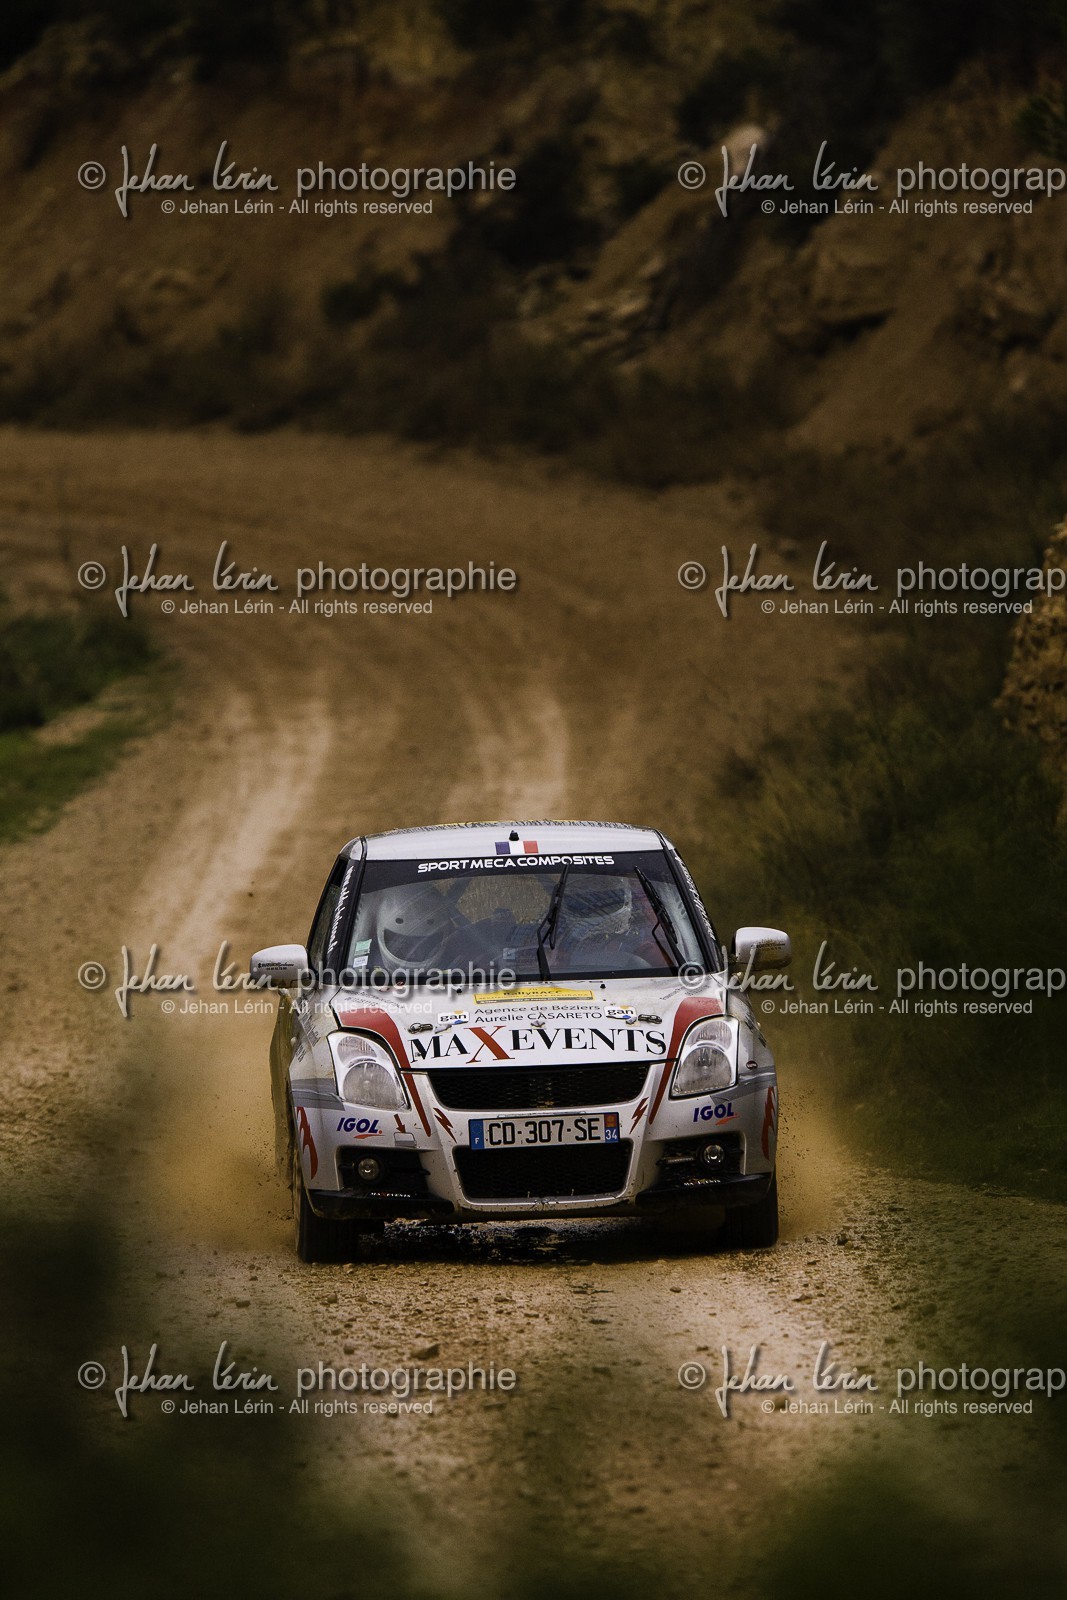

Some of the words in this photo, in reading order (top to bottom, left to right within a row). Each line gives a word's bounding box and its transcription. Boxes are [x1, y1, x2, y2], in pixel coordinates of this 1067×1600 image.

[474, 1007, 519, 1015] Agence
[551, 1004, 601, 1012] Béziers
[607, 1009, 635, 1017] gan
[440, 1014, 467, 1023] gan
[475, 1014, 524, 1023] Aurelie
[527, 1011, 602, 1021] CASARETO
[488, 1118, 600, 1146] CD-307-SE
[605, 1128, 618, 1141] 34
